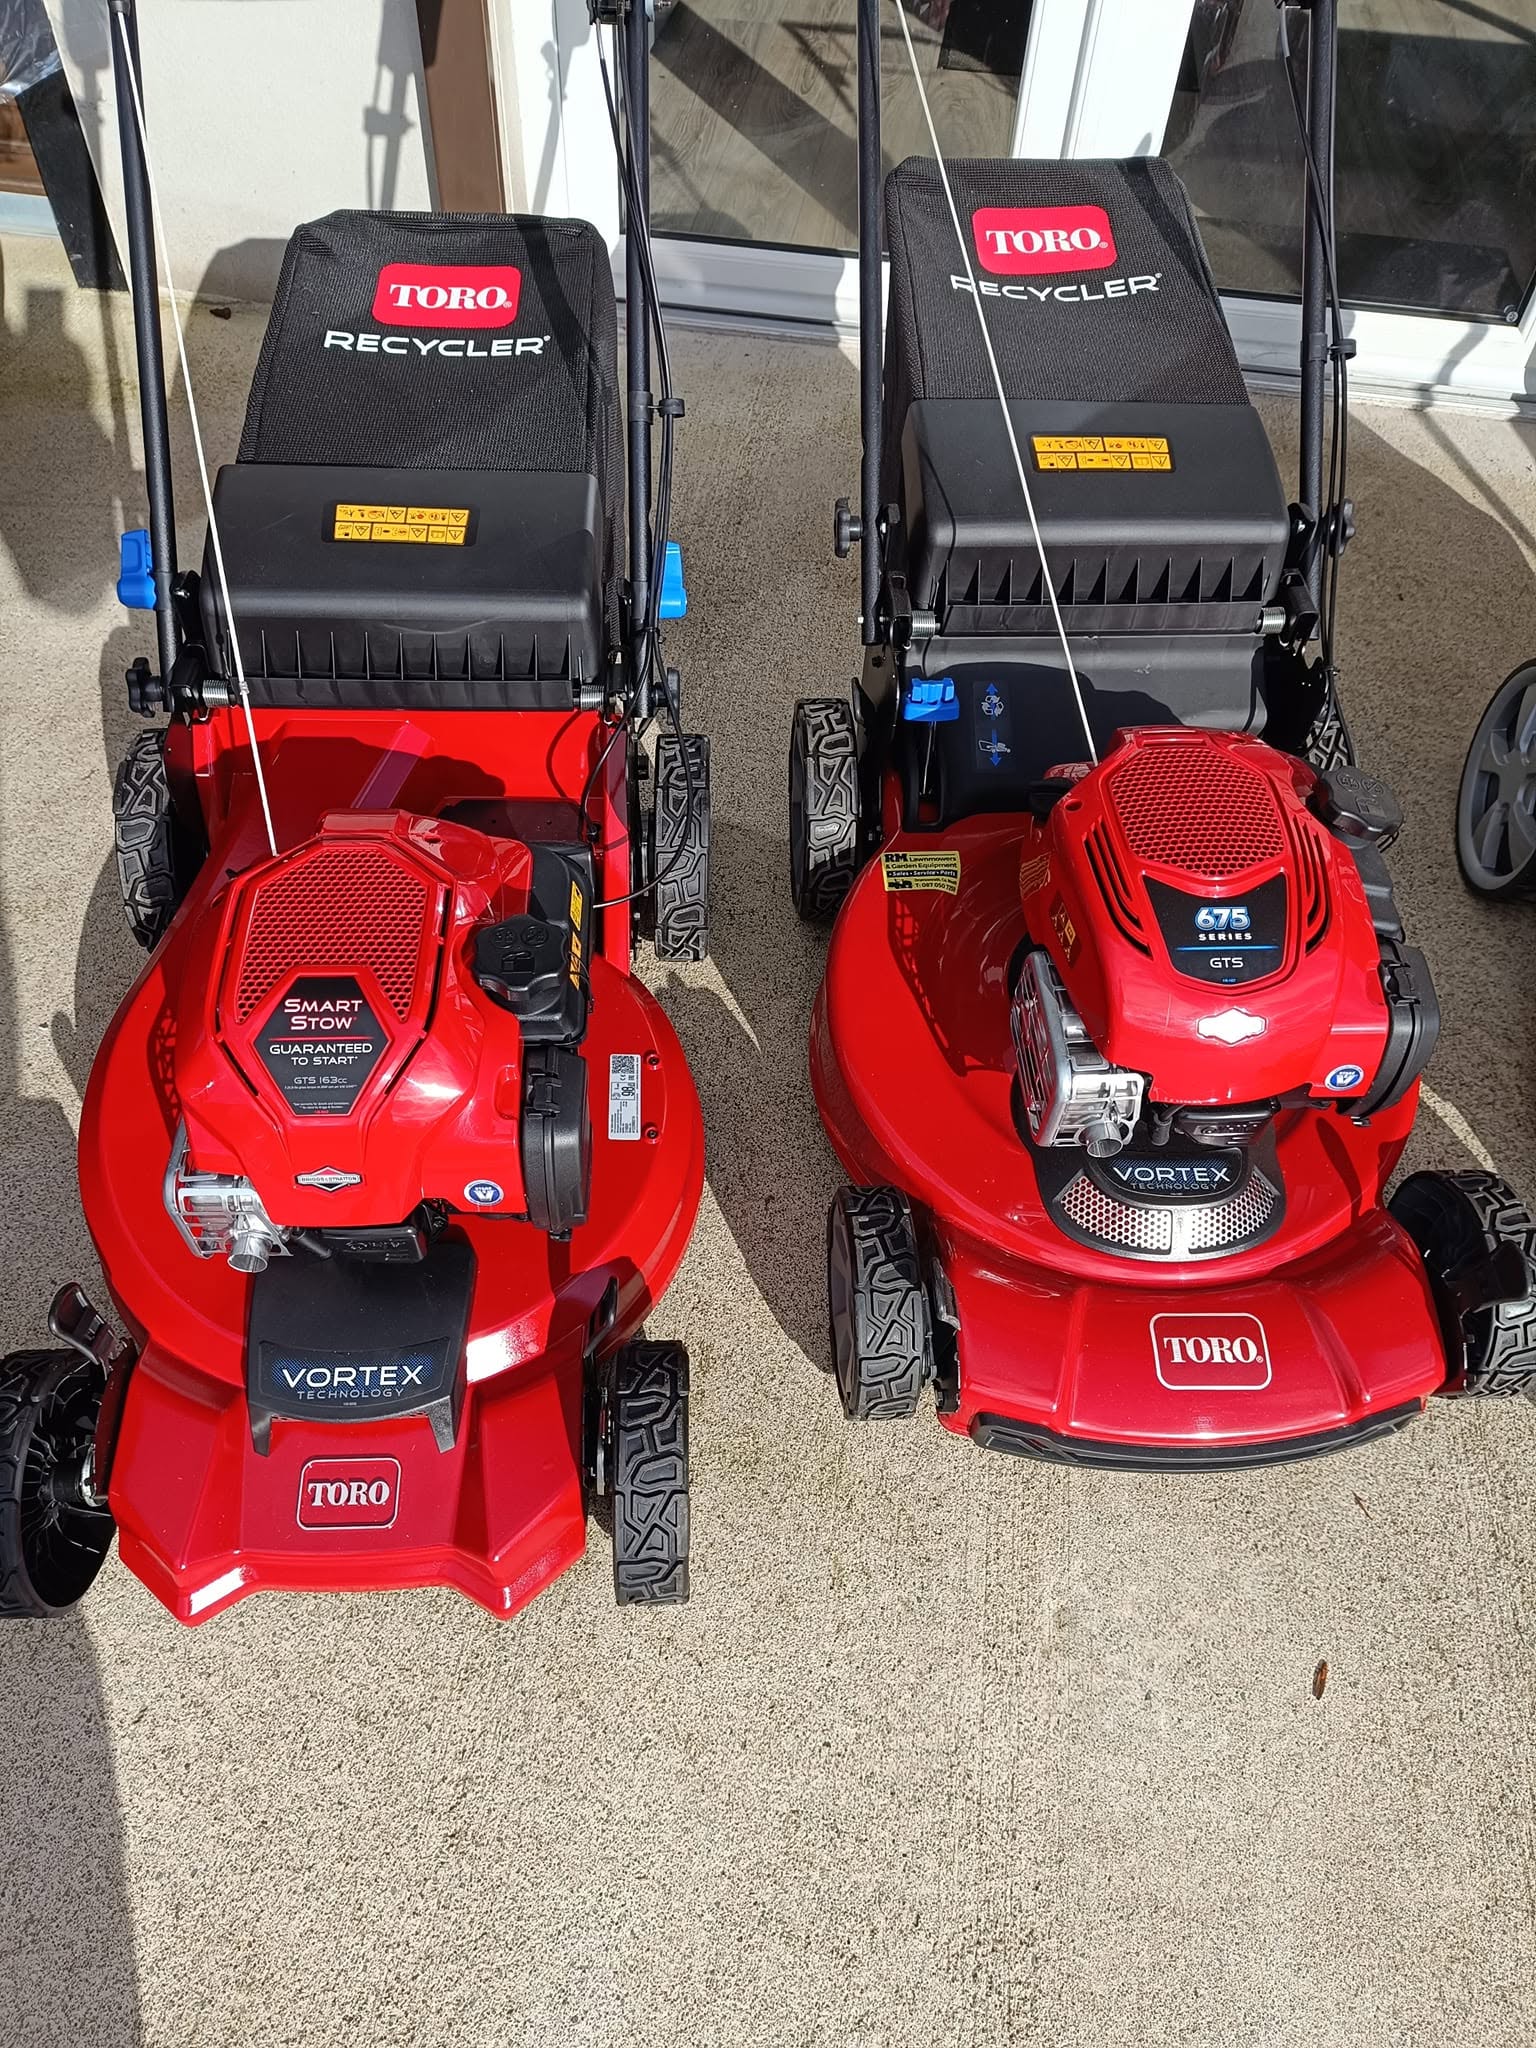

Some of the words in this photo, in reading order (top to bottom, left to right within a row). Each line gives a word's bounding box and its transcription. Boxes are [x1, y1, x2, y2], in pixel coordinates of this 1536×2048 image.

[884, 853, 908, 862] RM
[1195, 906, 1251, 931] 675
[1198, 933, 1253, 941] SERIES
[1209, 957, 1244, 969] GTS
[284, 998, 363, 1013] SMART
[269, 1043, 373, 1055] GUARANTEED
[291, 1057, 309, 1066] TO
[294, 1077, 316, 1085] GTS
[1113, 1167, 1231, 1182] VORTEX
[282, 1365, 423, 1389] VORTEX
[297, 1388, 404, 1400] TECHNOLOGY
[308, 1481, 390, 1506] TORO
